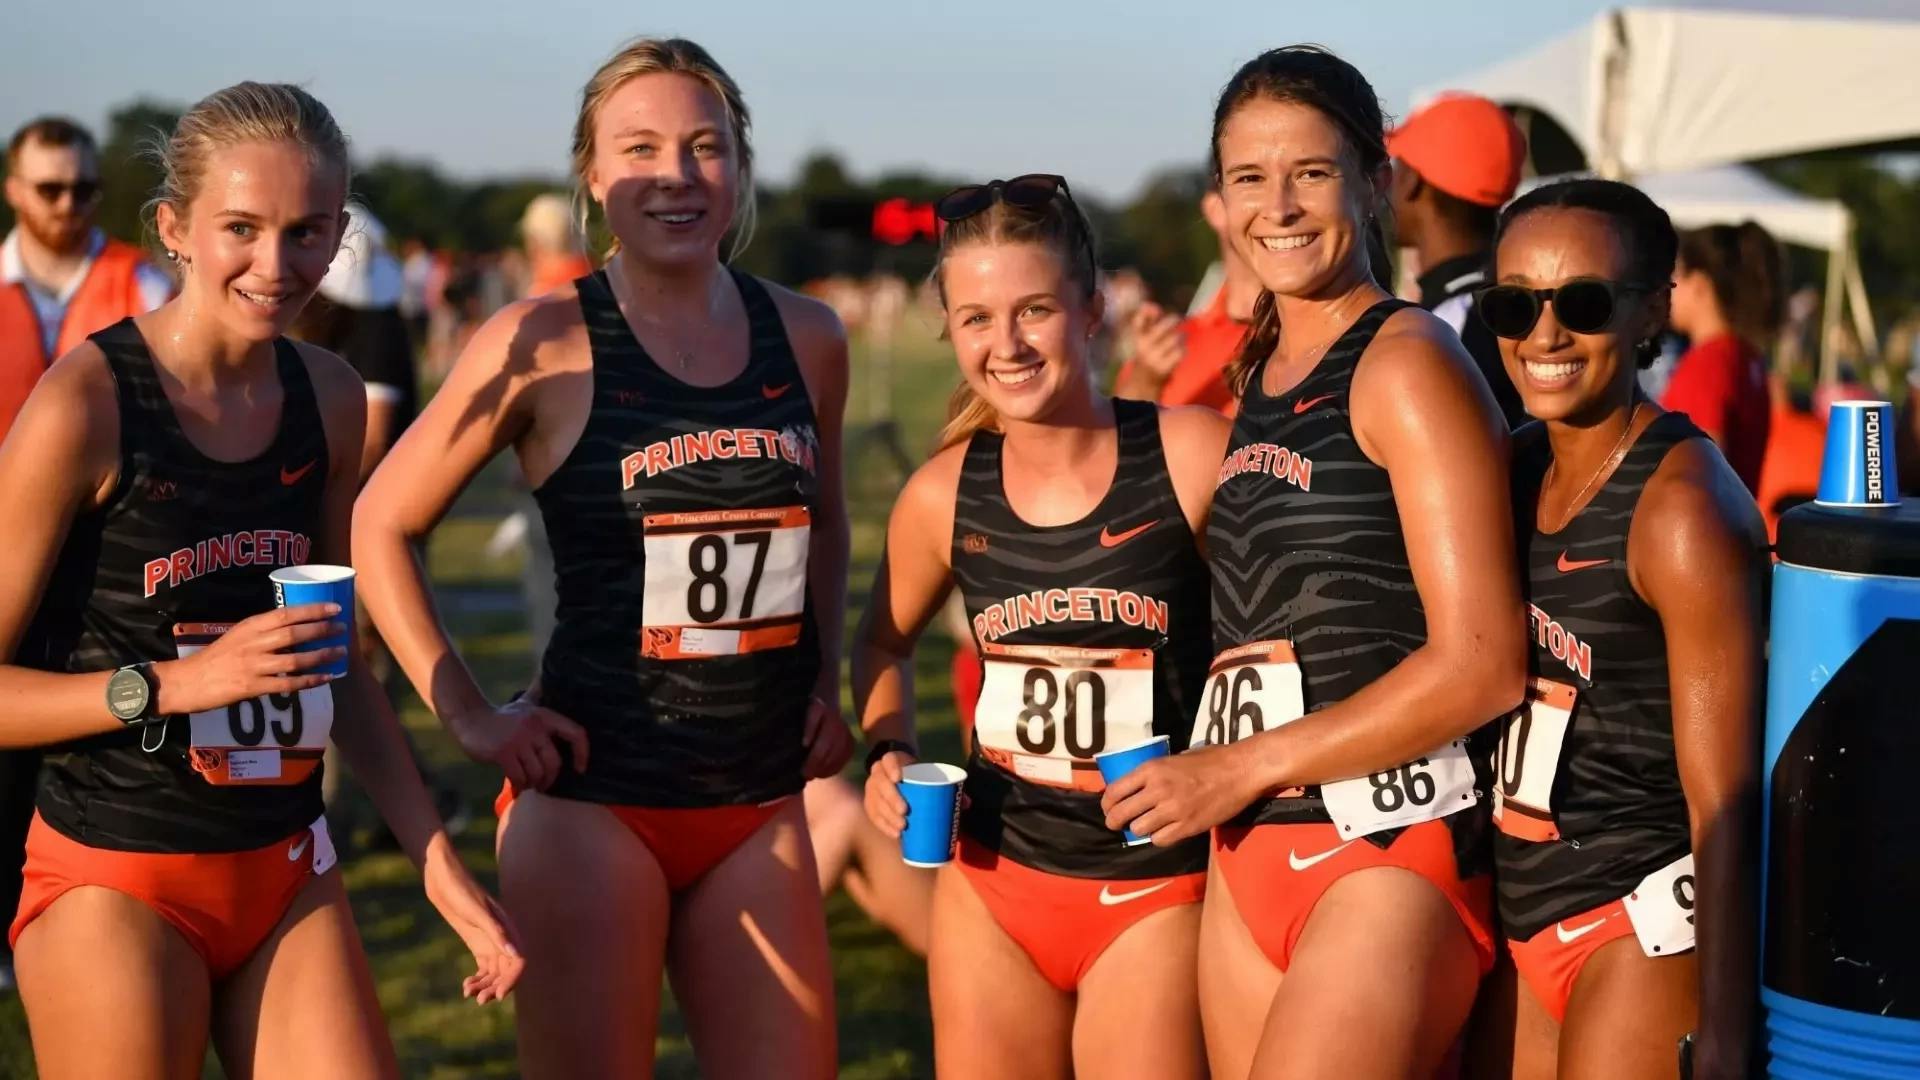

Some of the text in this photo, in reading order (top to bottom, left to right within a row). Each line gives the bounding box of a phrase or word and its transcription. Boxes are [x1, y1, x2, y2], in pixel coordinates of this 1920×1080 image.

[1866, 411, 1882, 503] POWERADE
[673, 509, 788, 524] Princeton Cross Country
[144, 529, 312, 598] PRINCETO
[687, 531, 772, 624] 87
[973, 587, 1169, 646] PRINCETON
[1016, 667, 1106, 759] 80
[1205, 666, 1265, 745] 86
[1368, 757, 1435, 813] 86
